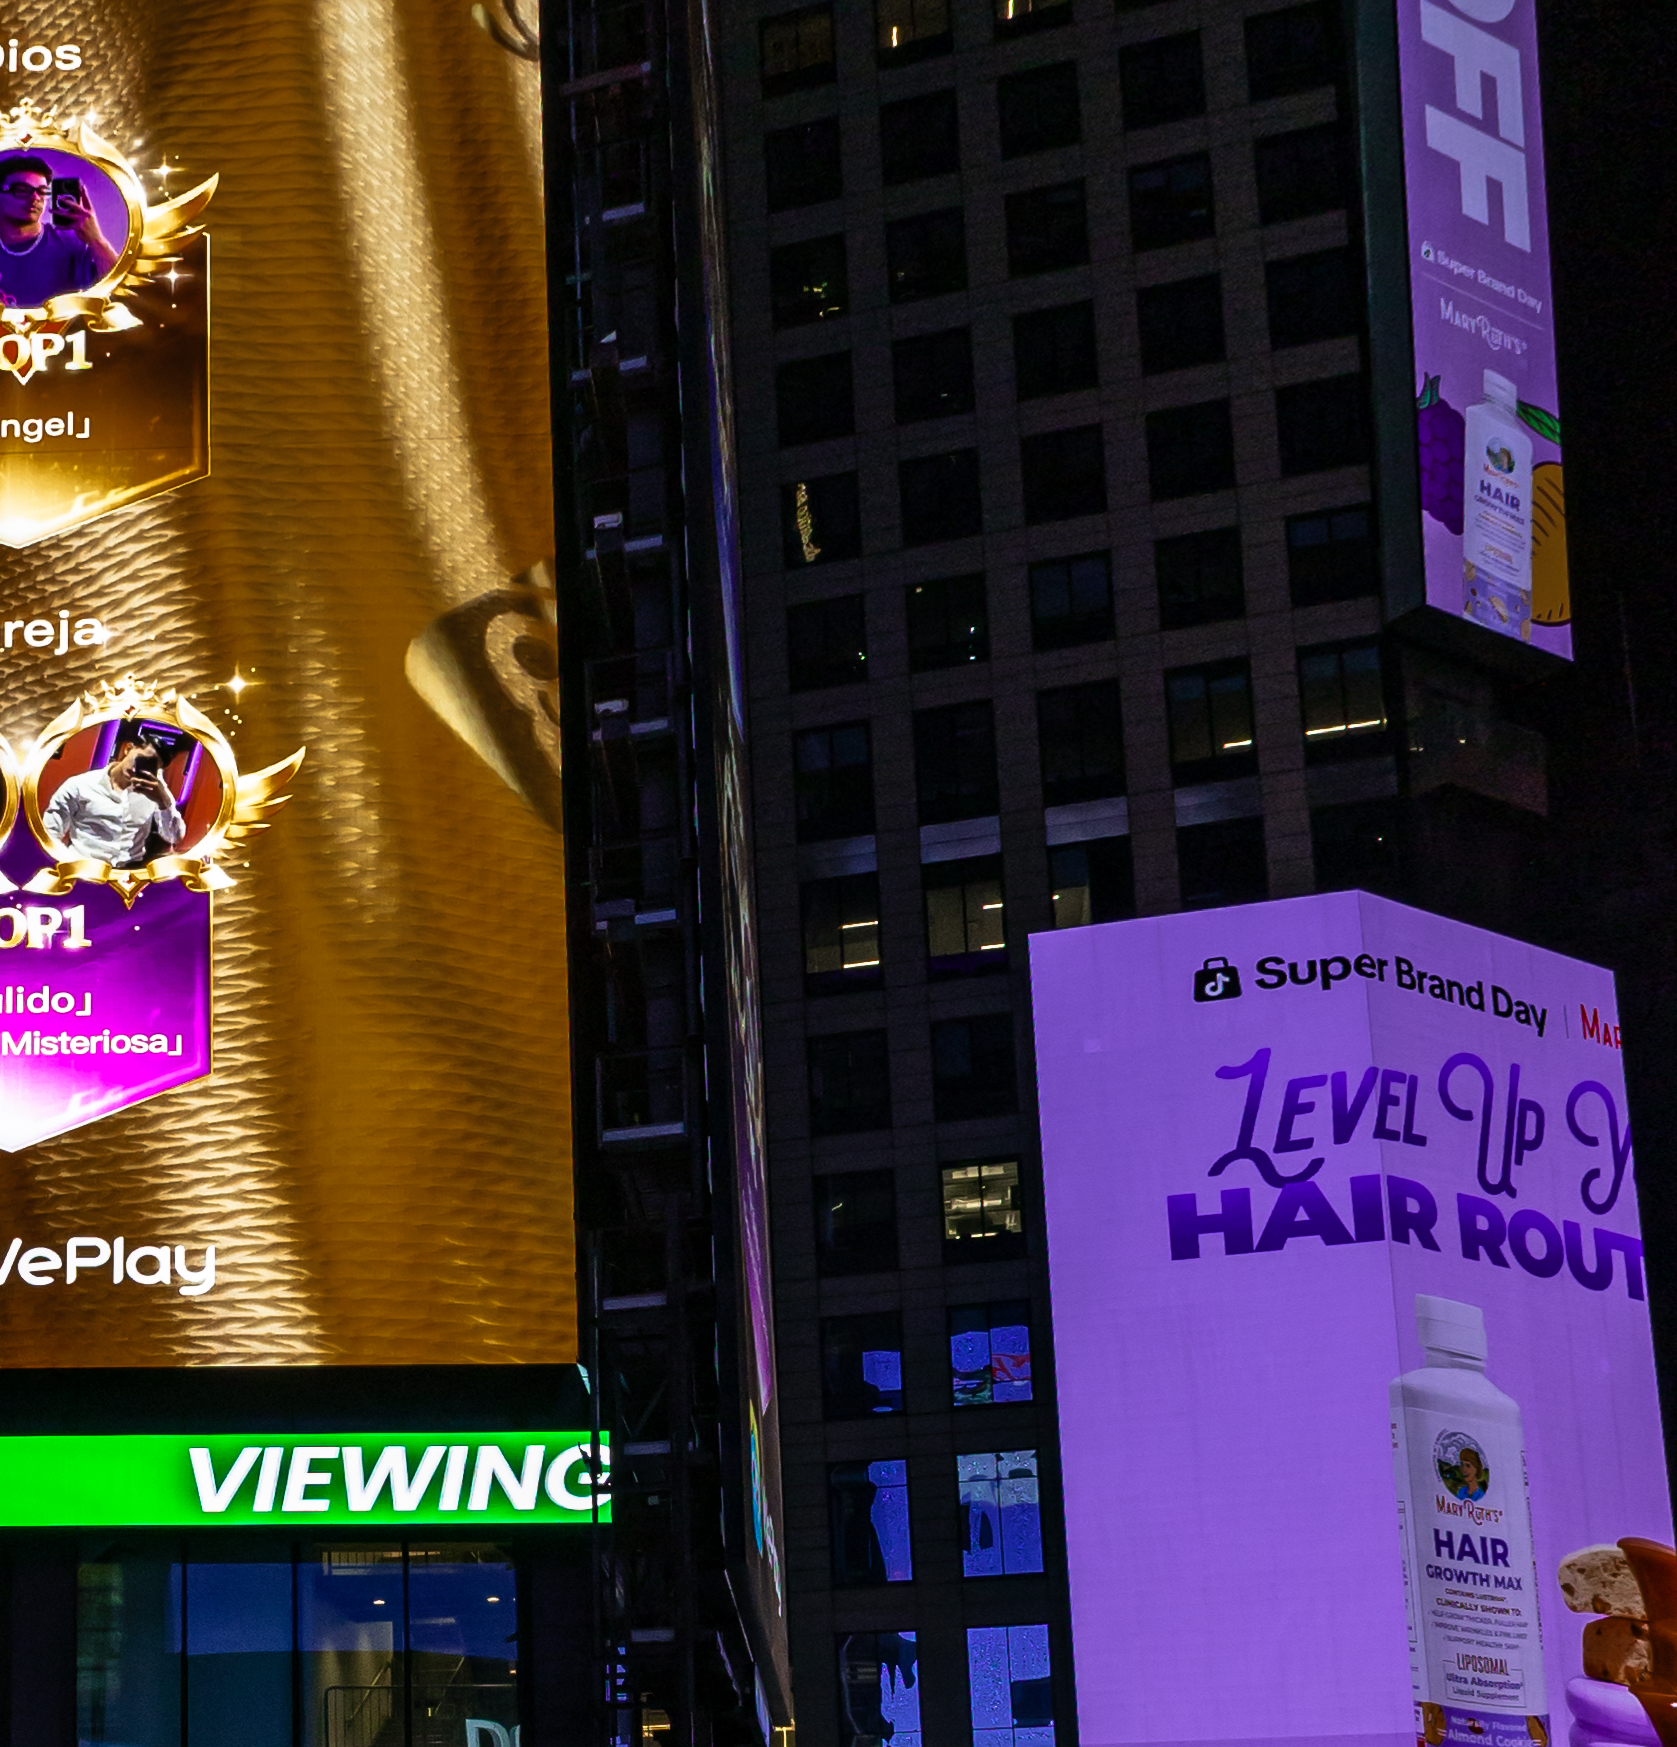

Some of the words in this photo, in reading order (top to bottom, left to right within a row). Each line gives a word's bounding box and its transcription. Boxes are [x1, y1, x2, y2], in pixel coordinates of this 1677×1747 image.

[1479, 479, 1521, 512] HAIR
[1254, 953, 1388, 991] Super
[1395, 956, 1486, 1013] Brand
[1490, 986, 1548, 1038] Day
[1167, 1174, 1441, 1261] HAIR
[189, 1444, 612, 1514] VIEWING
[1433, 1528, 1511, 1568] HAIR
[1425, 1564, 1491, 1588] GROWTH
[1494, 1574, 1523, 1591] MAX
[1456, 1653, 1510, 1676] LIPOSOMAL
